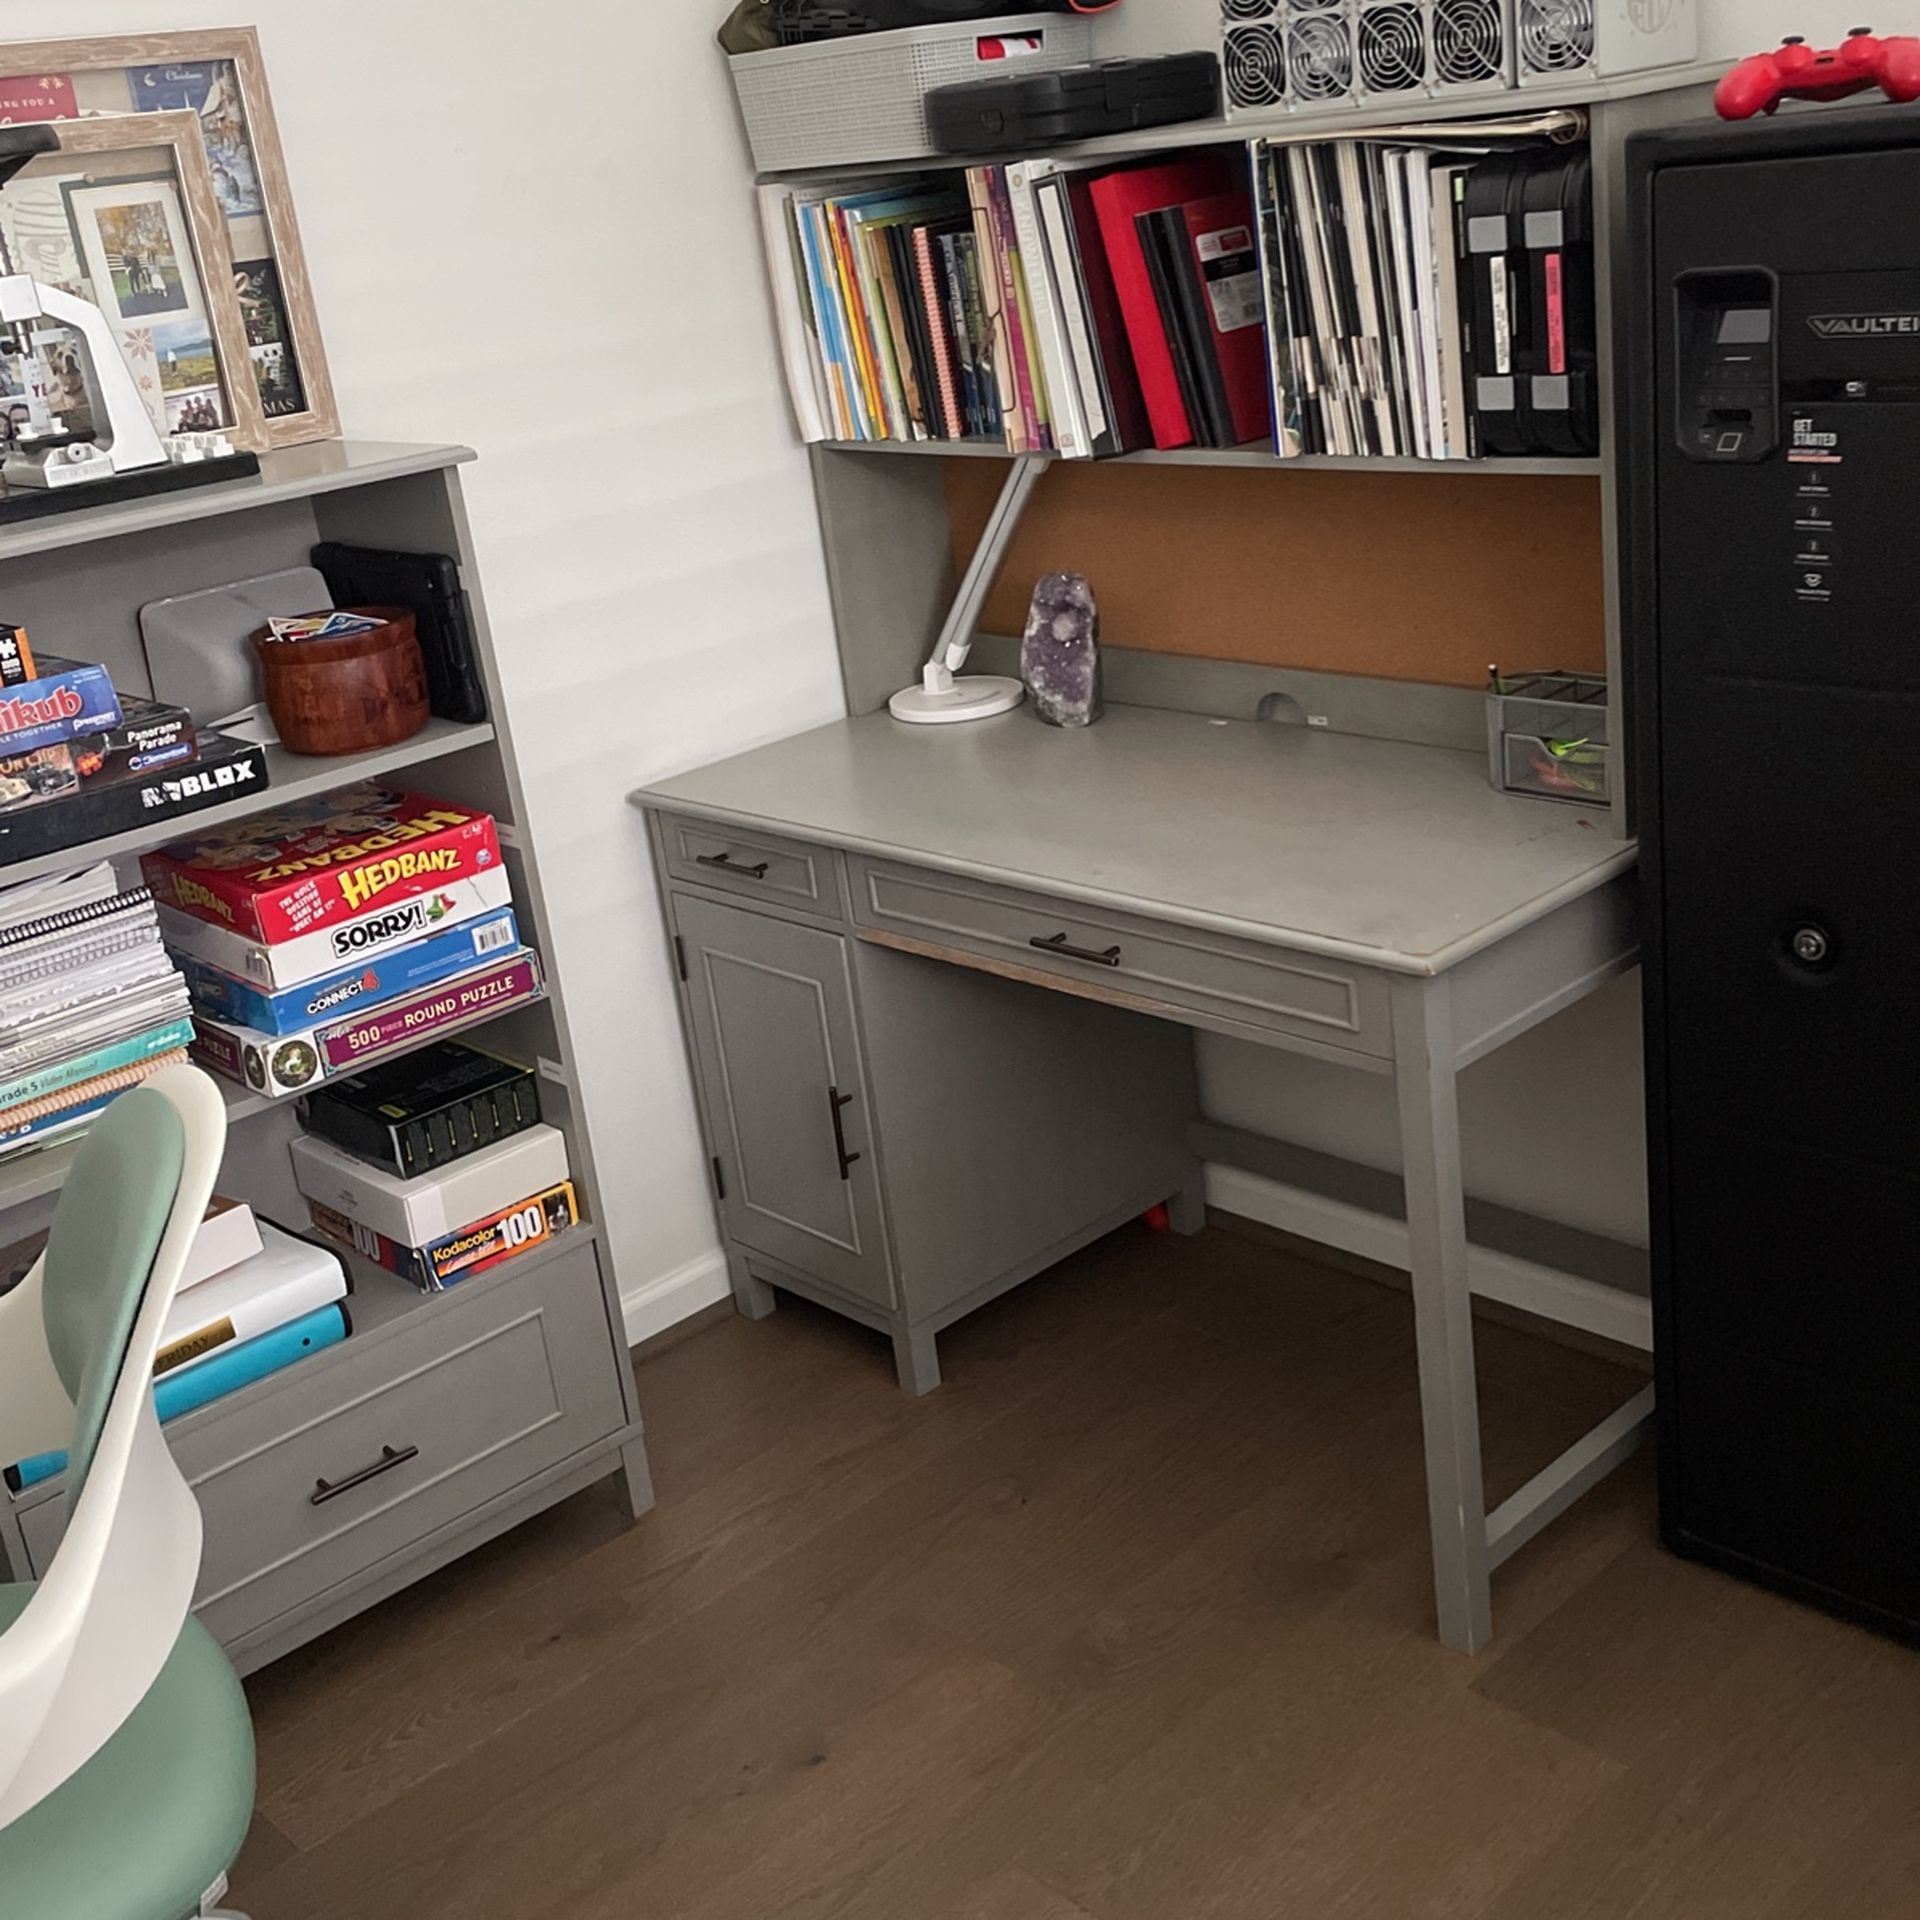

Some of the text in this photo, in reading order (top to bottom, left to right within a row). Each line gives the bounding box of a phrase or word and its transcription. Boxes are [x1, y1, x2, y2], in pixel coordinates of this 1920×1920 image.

[0, 100, 18, 109] NG
[1793, 419, 1813, 433] GET
[1793, 432, 1837, 447] STARTED
[14, 722, 64, 741] TOGETHER
[127, 721, 183, 742] Panorama
[139, 733, 178, 752] Parade
[141, 760, 257, 808] ROBLOX
[337, 849, 462, 911] HEDBANZ
[278, 896, 294, 909] THE
[292, 905, 312, 922] GAME
[313, 907, 325, 919] AM
[335, 904, 424, 954] SORRY!
[306, 979, 366, 1015] CONNECT
[348, 1024, 381, 1050] 500
[403, 998, 458, 1029] ROUND
[460, 975, 516, 1005] PUZZLE
[432, 1223, 496, 1263] Kodacolor
[497, 1205, 543, 1250] 100
[157, 1332, 209, 1371] FRIDAY
